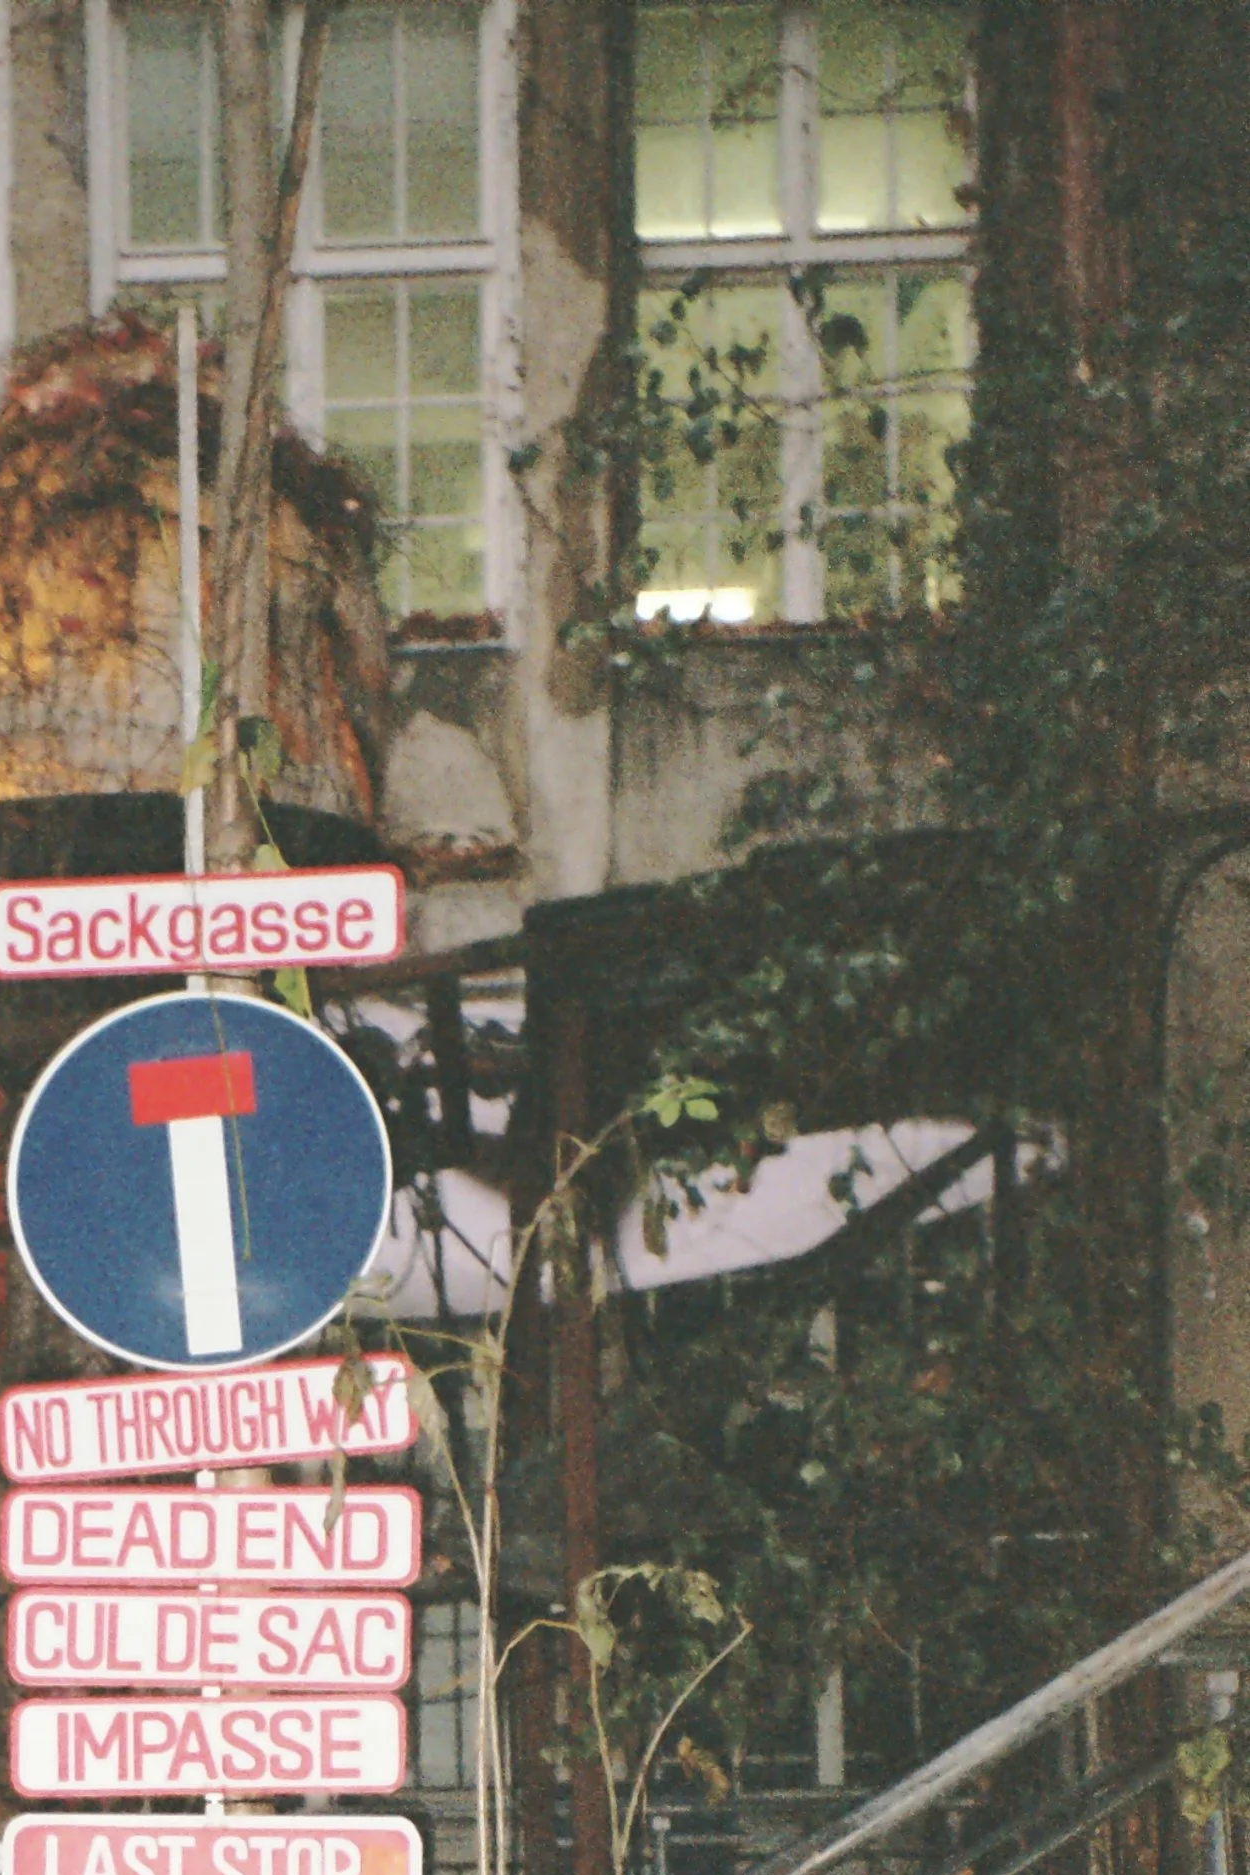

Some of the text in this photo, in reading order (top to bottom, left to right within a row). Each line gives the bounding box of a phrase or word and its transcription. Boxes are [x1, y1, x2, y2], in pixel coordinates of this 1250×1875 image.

[4, 892, 375, 964] Sackgasse
[11, 1397, 72, 1471] NO
[86, 1377, 288, 1465] THROUGH
[21, 1500, 389, 1570] DEAD END
[24, 1601, 396, 1676] CUL DE SAC
[56, 1708, 362, 1783] IMPASSE
